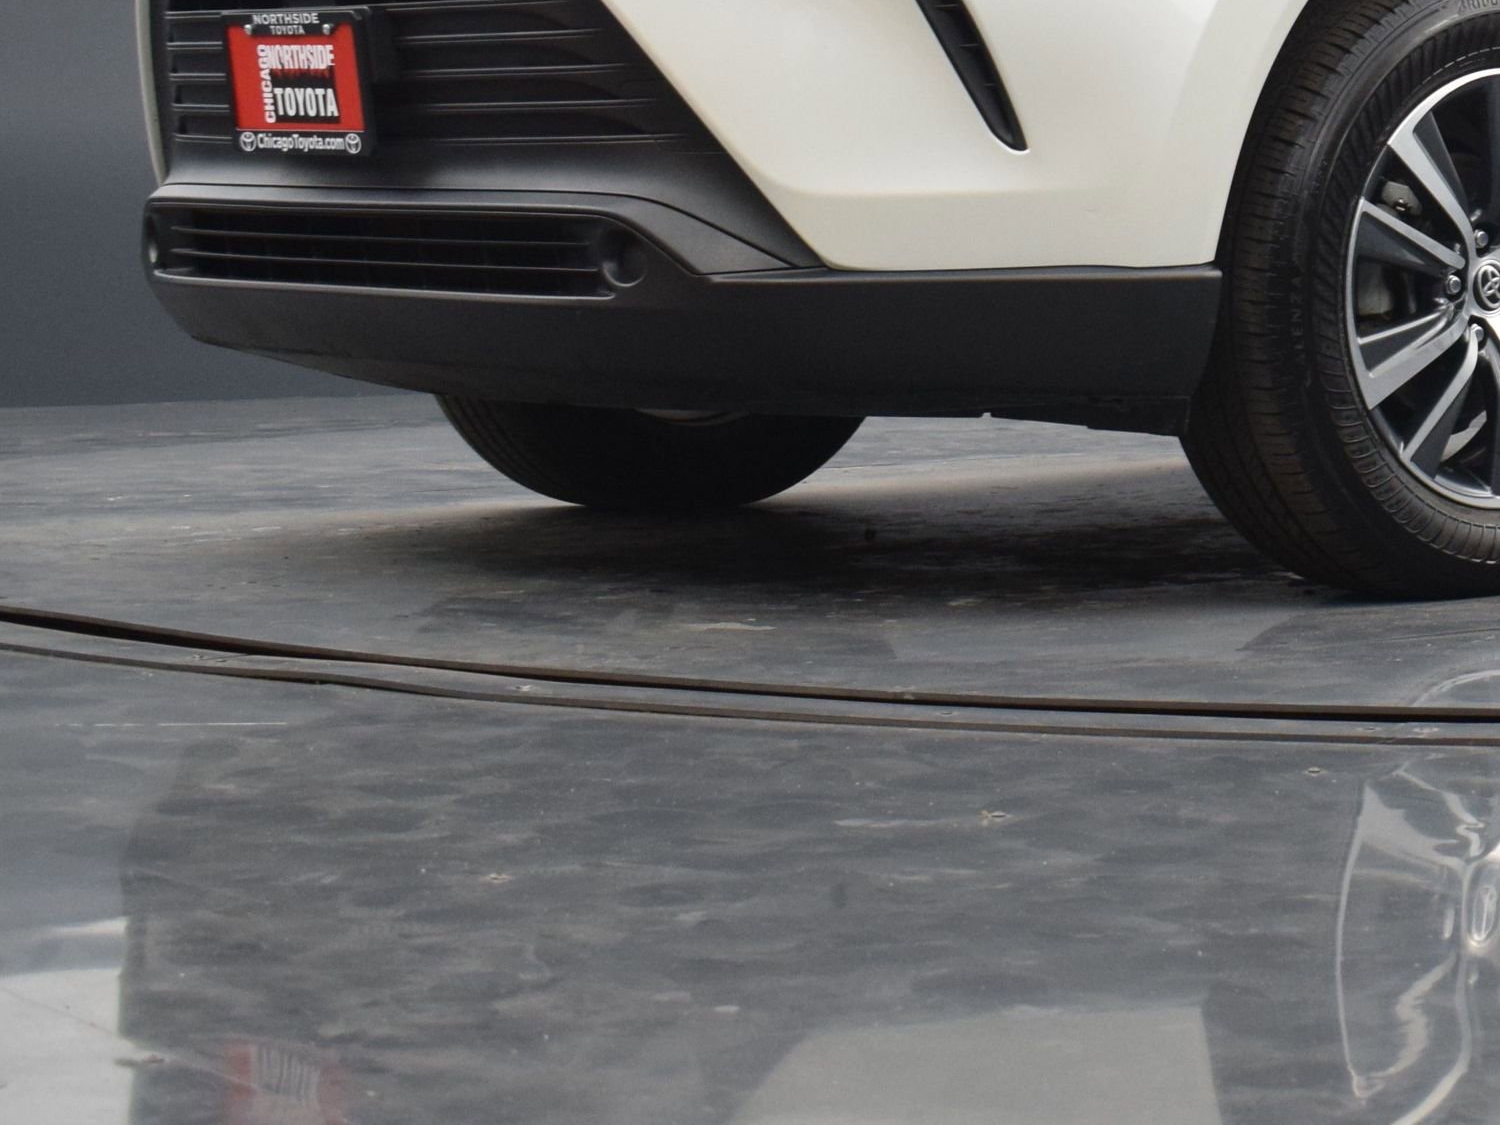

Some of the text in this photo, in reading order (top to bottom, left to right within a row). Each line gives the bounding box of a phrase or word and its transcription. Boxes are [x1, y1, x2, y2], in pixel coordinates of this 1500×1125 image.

[252, 13, 320, 24] NORTHSIDE
[269, 25, 305, 35] TOYOTA
[266, 44, 335, 69] NORTHSIDE
[257, 44, 276, 123] CHICAGO
[273, 87, 339, 116] TOYOTA
[257, 133, 345, 152] ChicagoToyota.com
